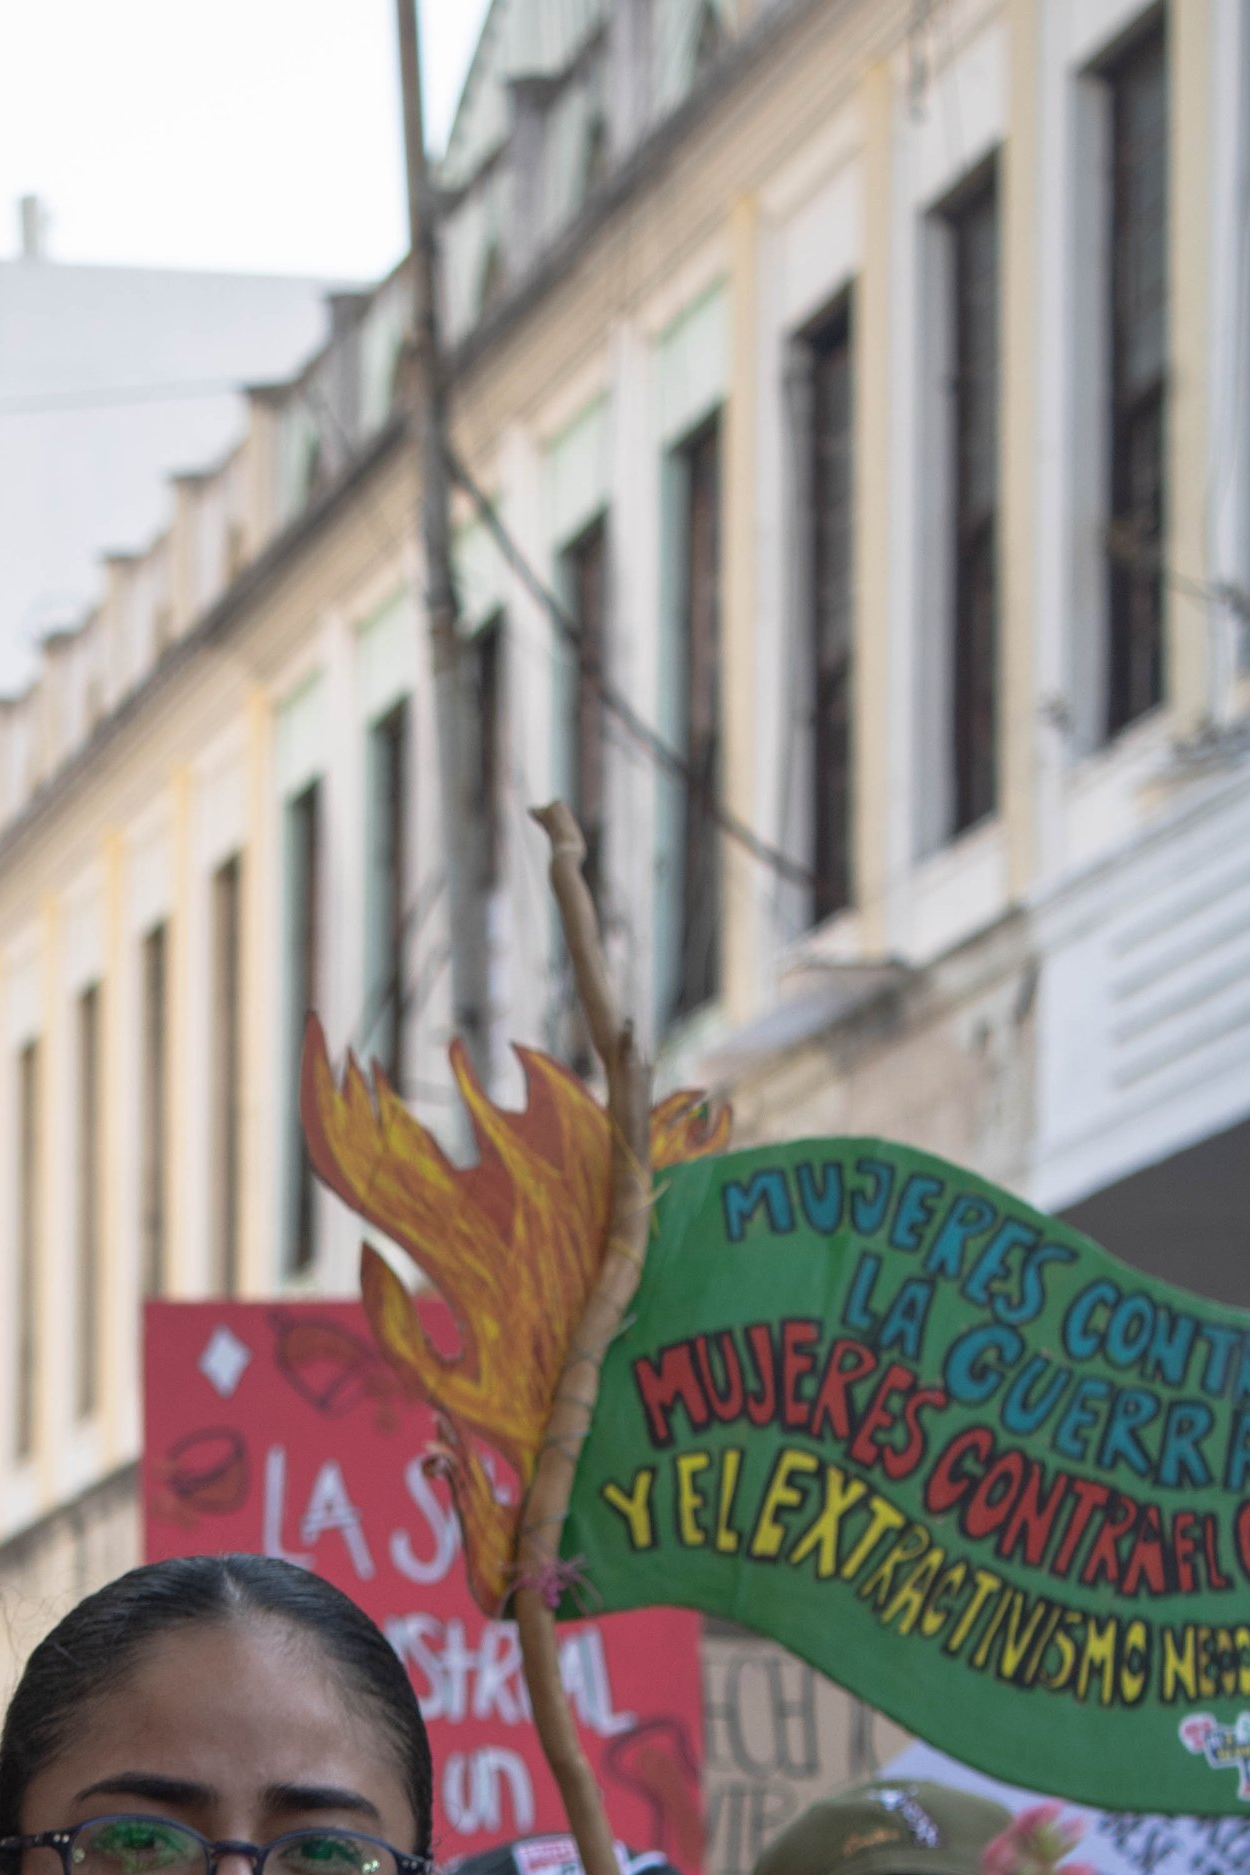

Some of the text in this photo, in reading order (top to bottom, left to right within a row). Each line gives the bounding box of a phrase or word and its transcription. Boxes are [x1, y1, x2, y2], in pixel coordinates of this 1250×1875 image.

[723, 1157, 1079, 1326] MUJERES
[843, 1252, 937, 1361] LA
[634, 1318, 951, 1482] MUJERES
[262, 1443, 377, 1582] LA
[600, 1467, 659, 1553] Y
